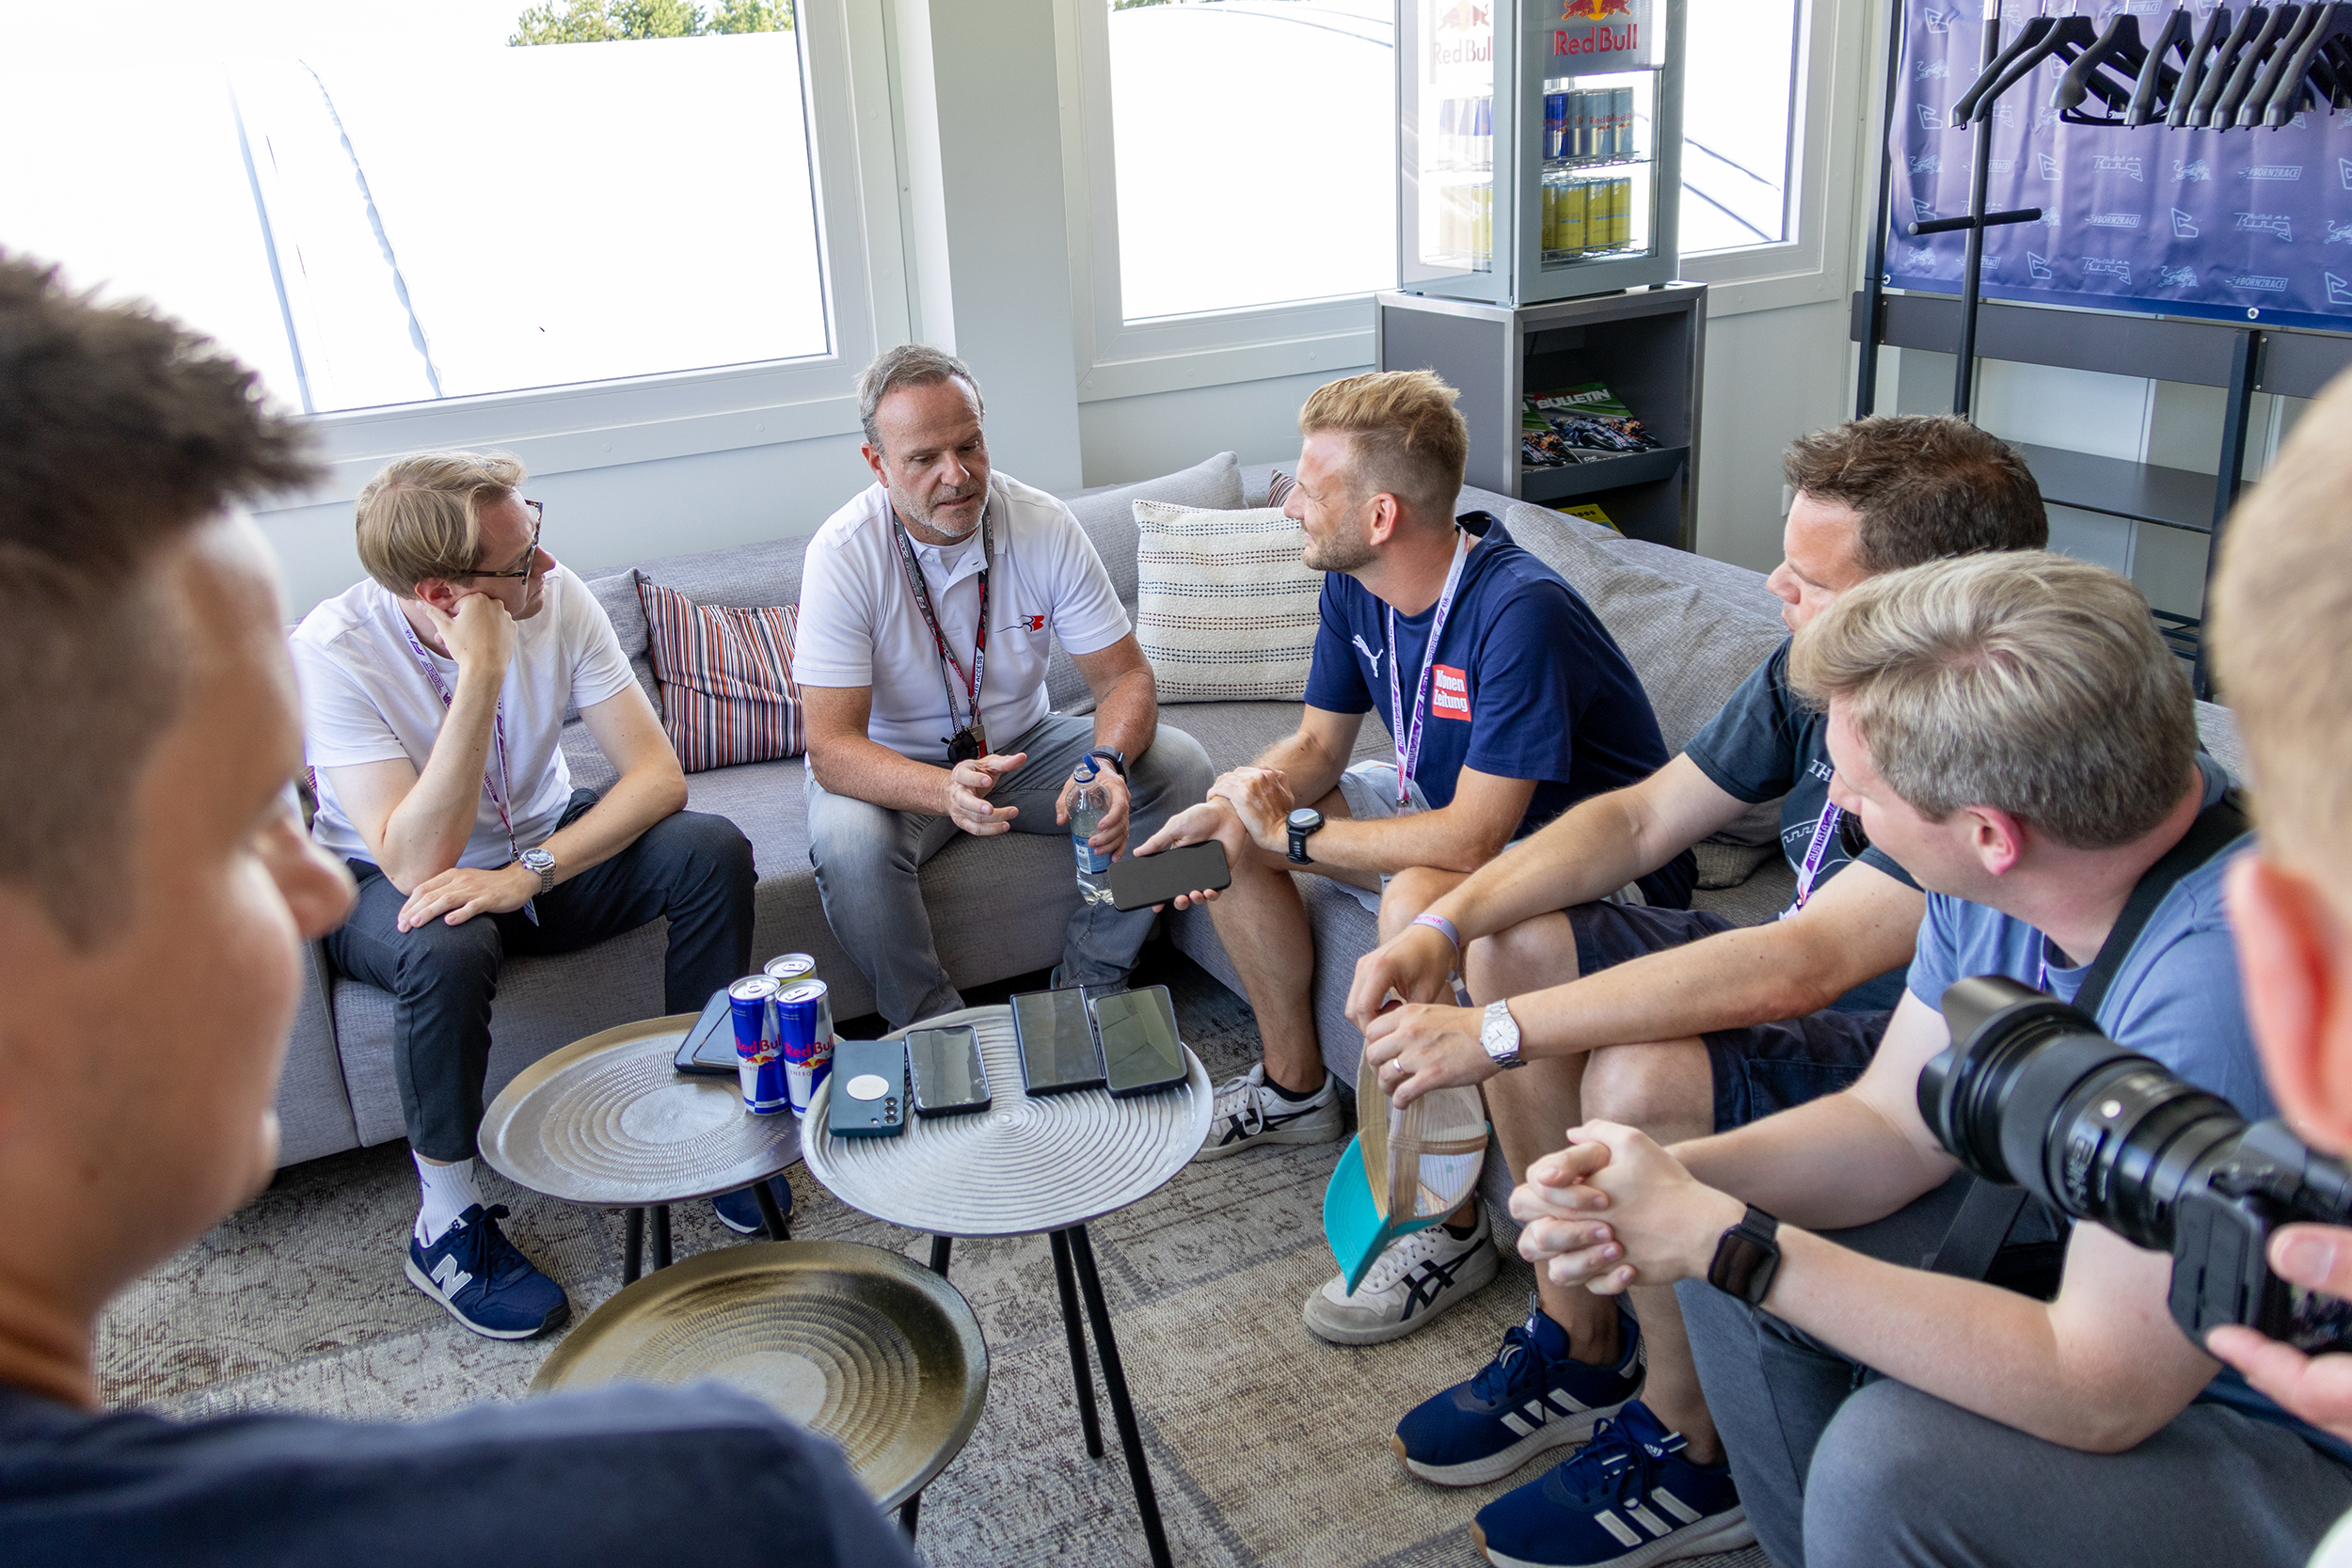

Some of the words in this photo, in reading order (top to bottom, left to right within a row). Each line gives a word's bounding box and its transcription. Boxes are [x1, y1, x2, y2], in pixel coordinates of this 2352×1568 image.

[1432, 39, 1462, 65] Red
[1554, 26, 1597, 56] Red
[1598, 24, 1639, 52] Bull
[1590, 115, 1606, 124] Red
[2235, 277, 2285, 289] #BORN2RACE
[1536, 388, 1611, 410] BULLETIN
[1433, 689, 1469, 713] Zeitung
[1395, 718, 1405, 747] AUSTRIA
[1808, 759, 1834, 783] TH
[1808, 825, 1829, 862] AUSTRIA
[736, 1036, 758, 1053] Red
[758, 1034, 782, 1053] Bul
[784, 1042, 812, 1058] Red
